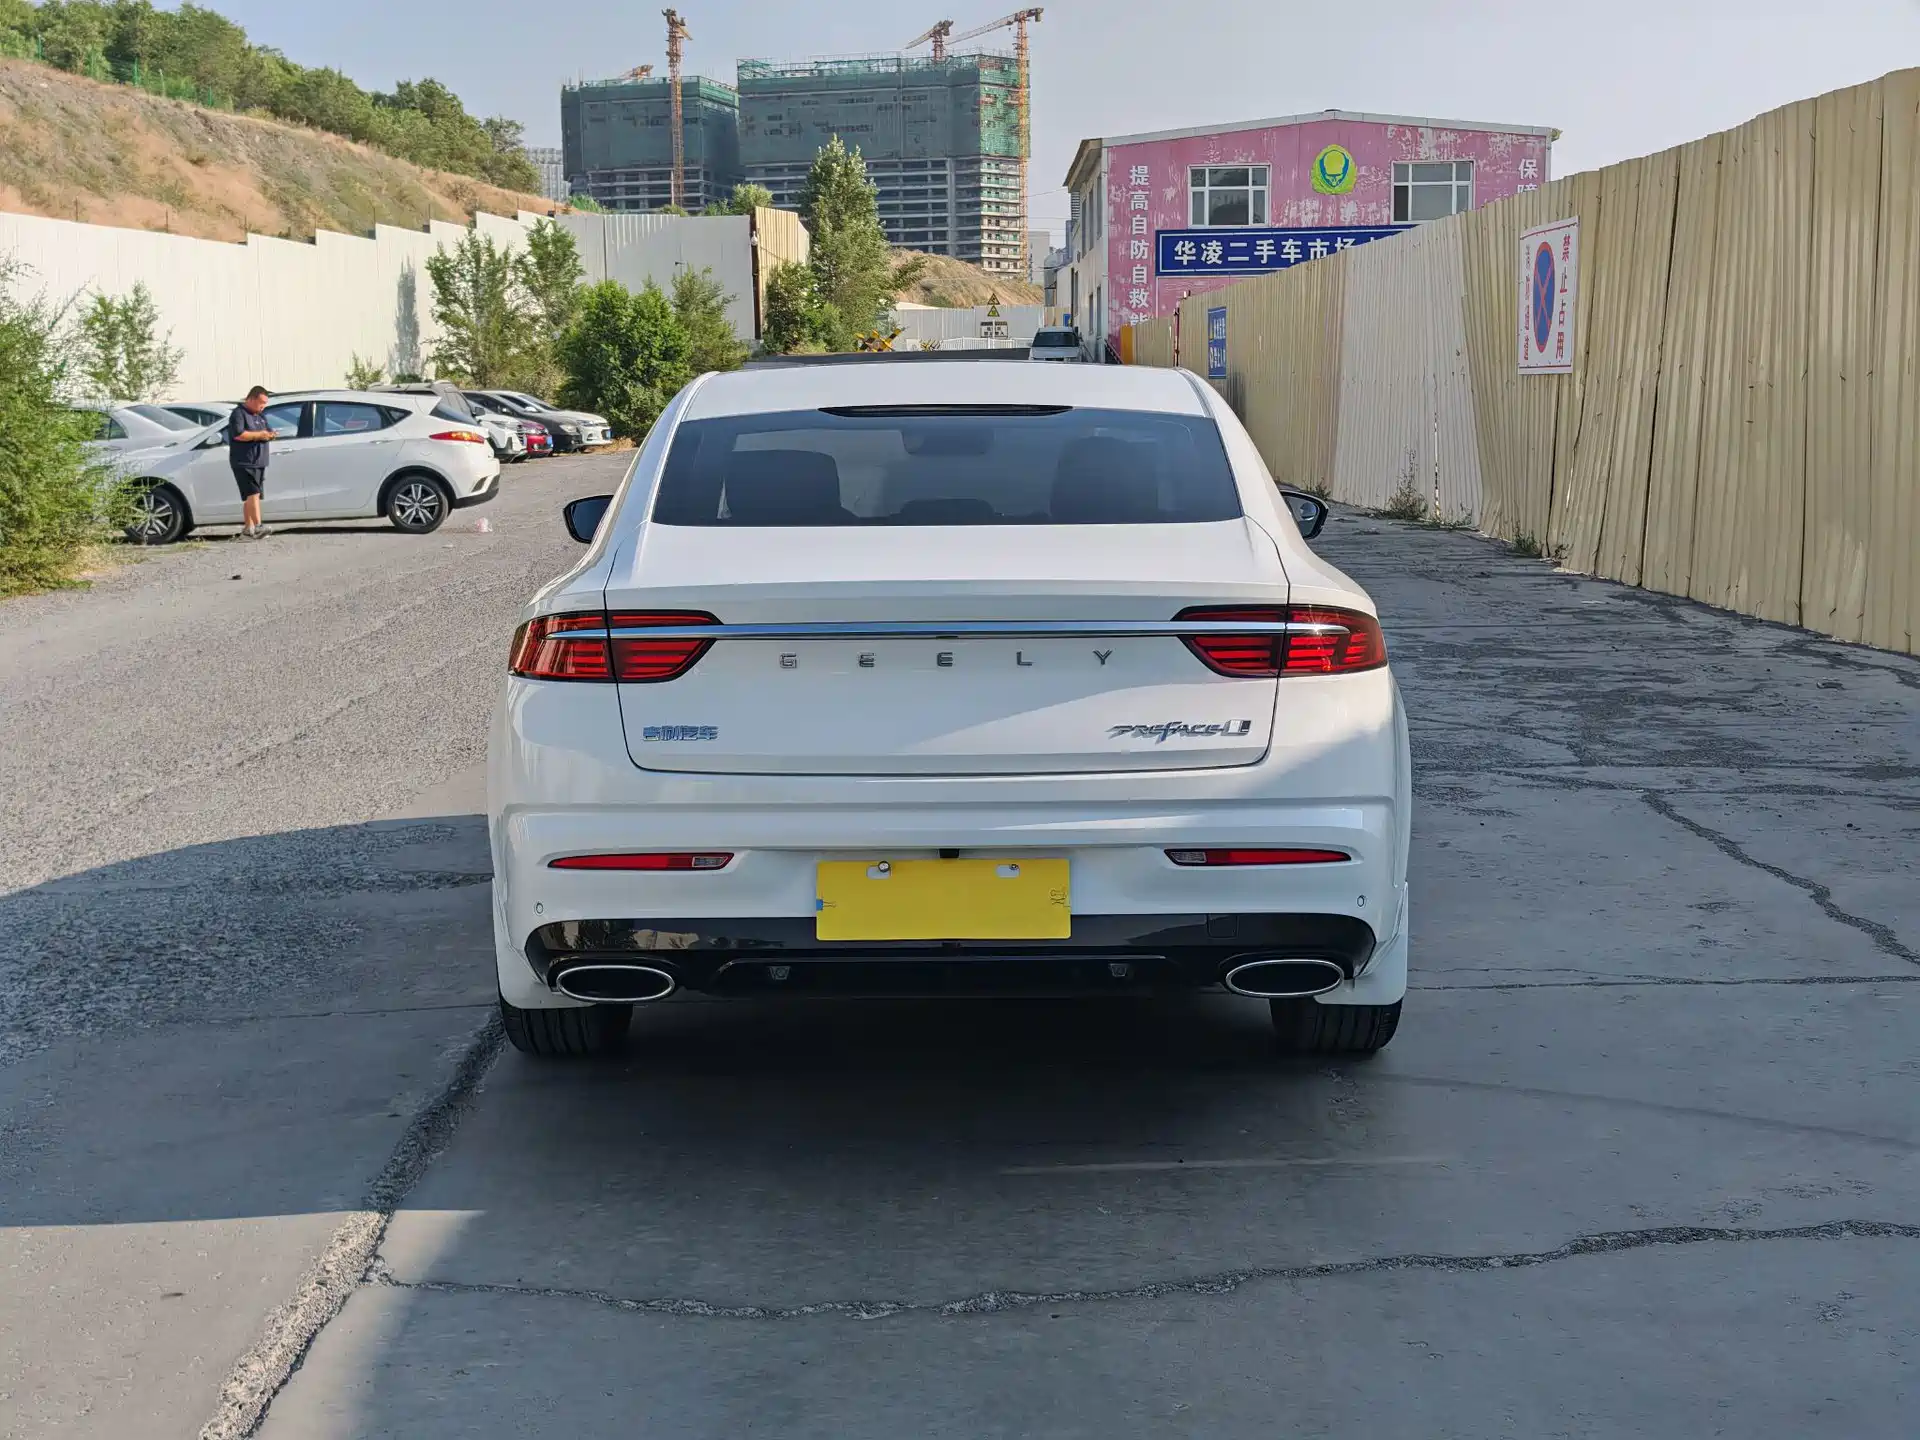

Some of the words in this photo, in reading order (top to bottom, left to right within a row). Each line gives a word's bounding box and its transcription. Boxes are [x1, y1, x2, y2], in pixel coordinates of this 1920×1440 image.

[1174, 237, 1375, 265] 华凌二手车市场
[1555, 233, 1571, 360] 禁止占用
[780, 650, 1113, 669] GEELY
[643, 725, 719, 741] 吉利汽车
